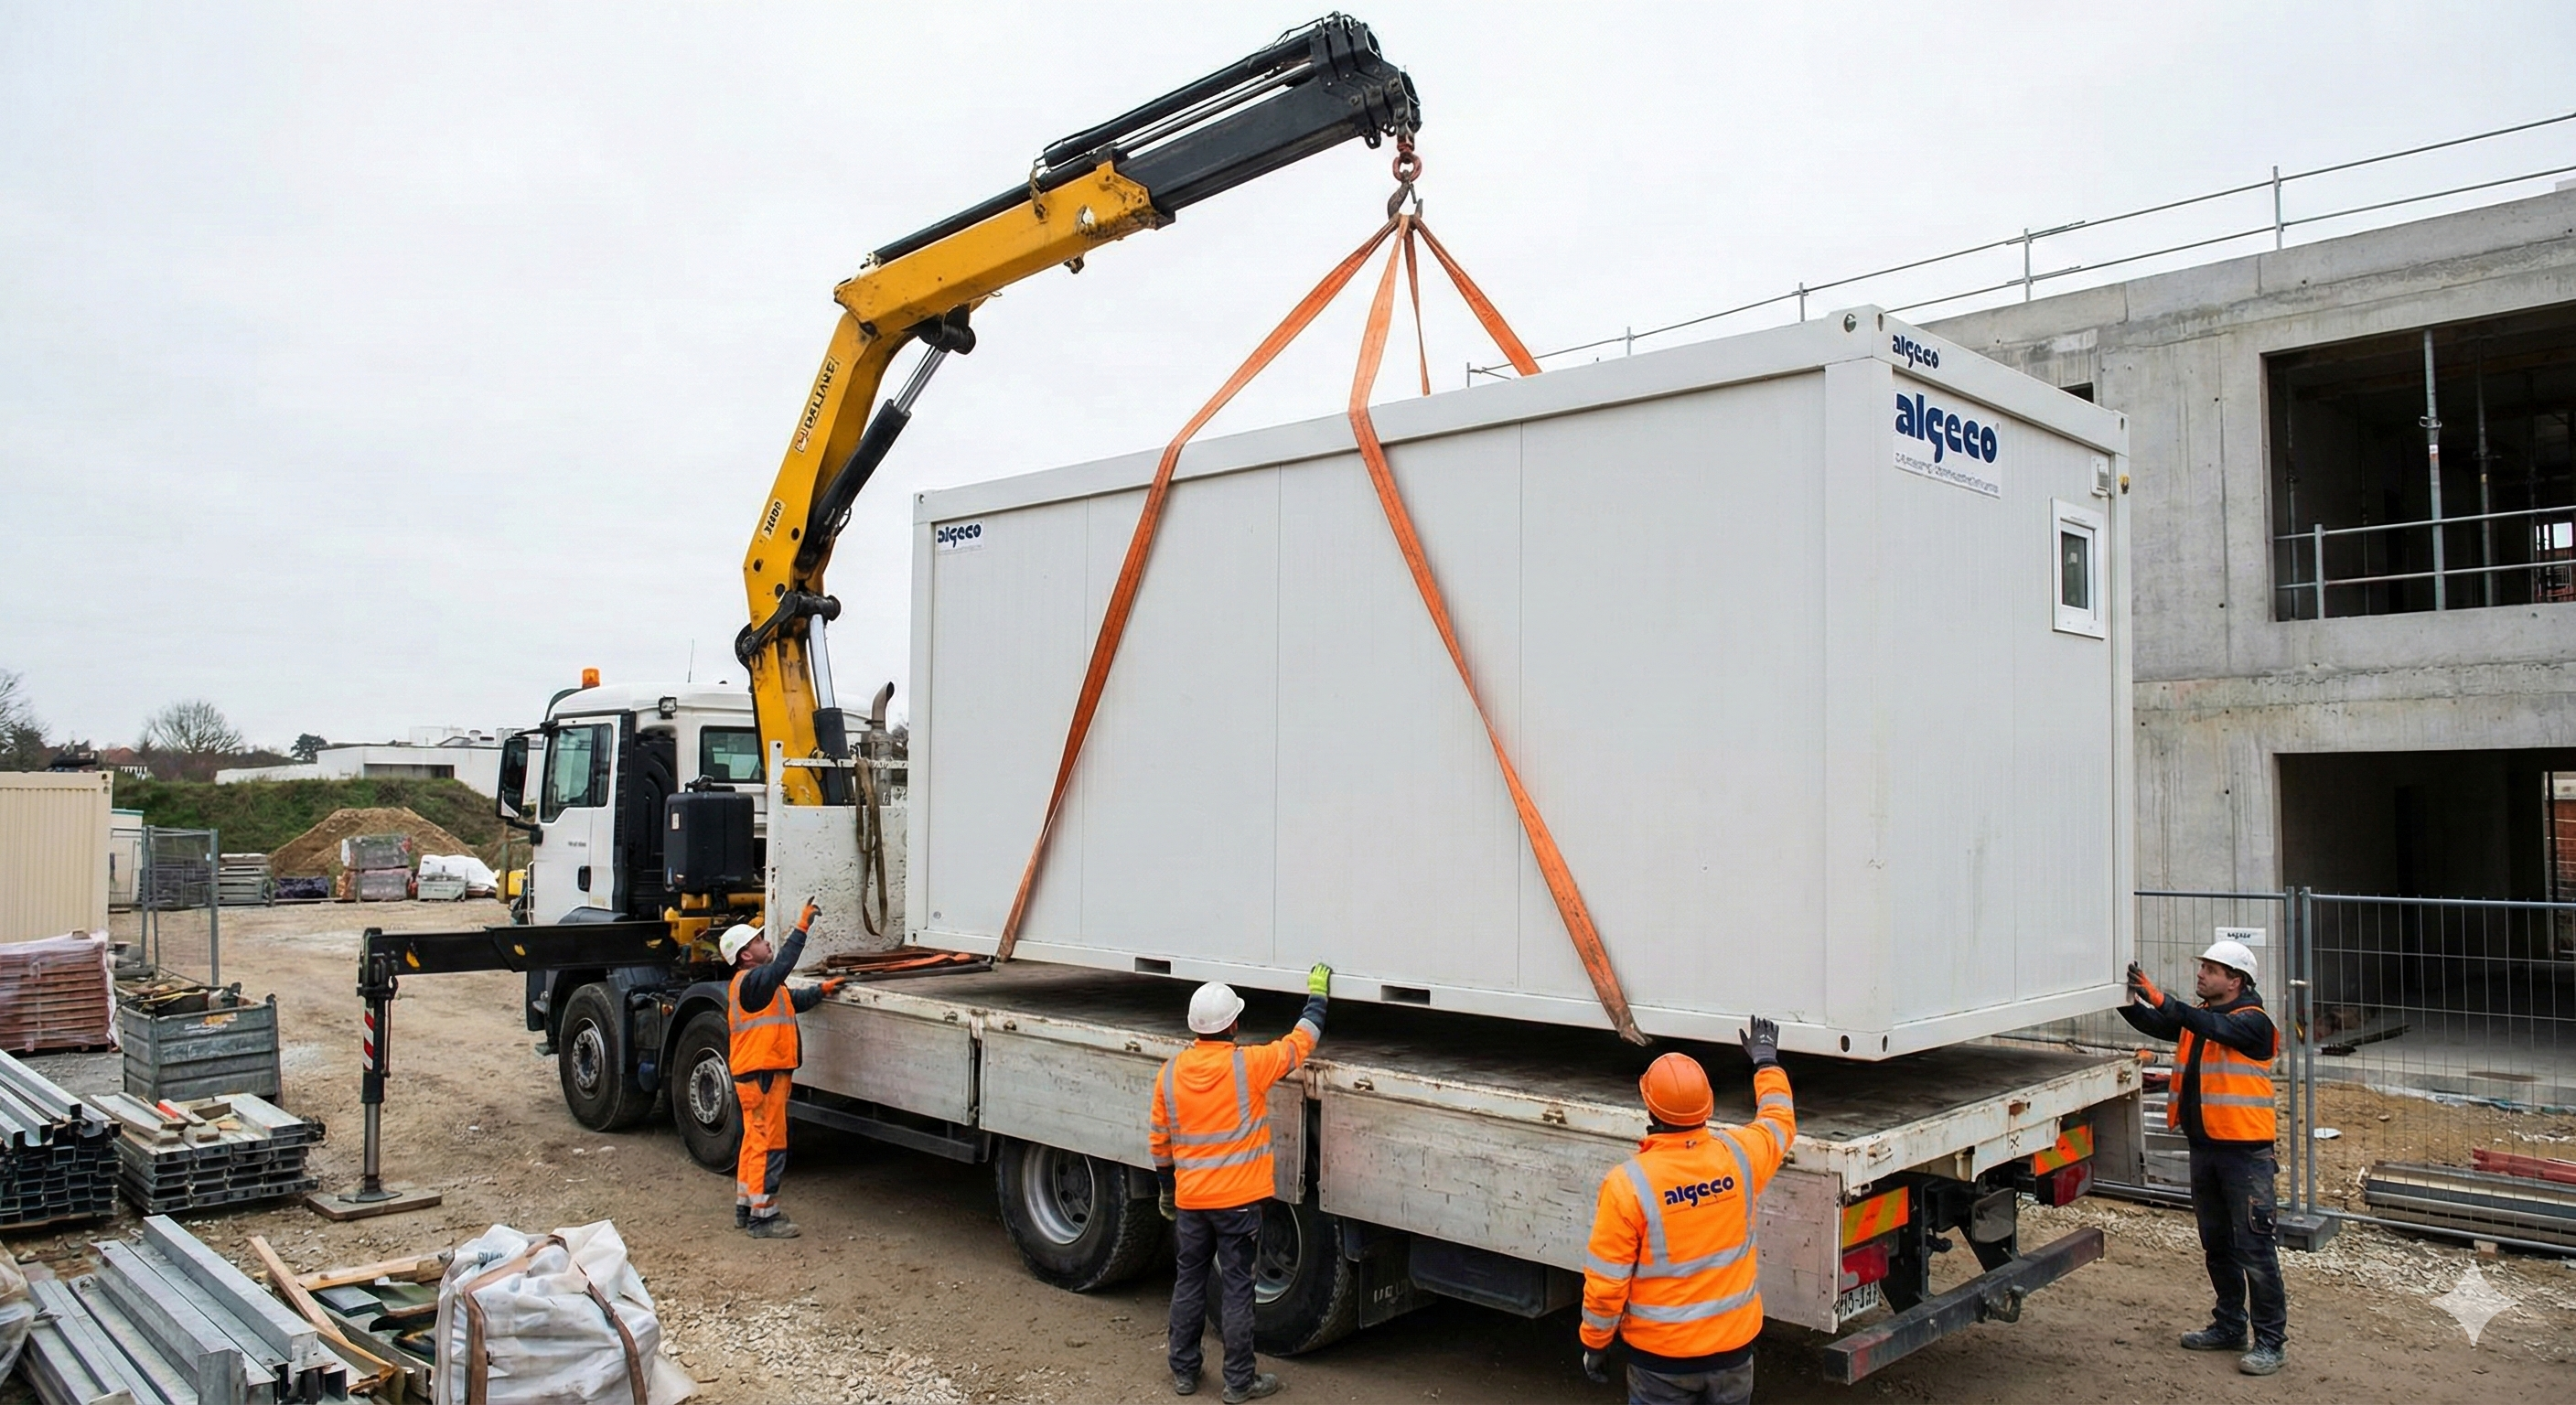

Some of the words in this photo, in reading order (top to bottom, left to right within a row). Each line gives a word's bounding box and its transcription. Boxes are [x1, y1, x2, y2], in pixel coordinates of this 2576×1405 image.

[1892, 334, 1939, 369] algeco
[1895, 392, 1998, 463] algeco
[937, 524, 982, 548] algeco
[1664, 1176, 1734, 1207] algeco
